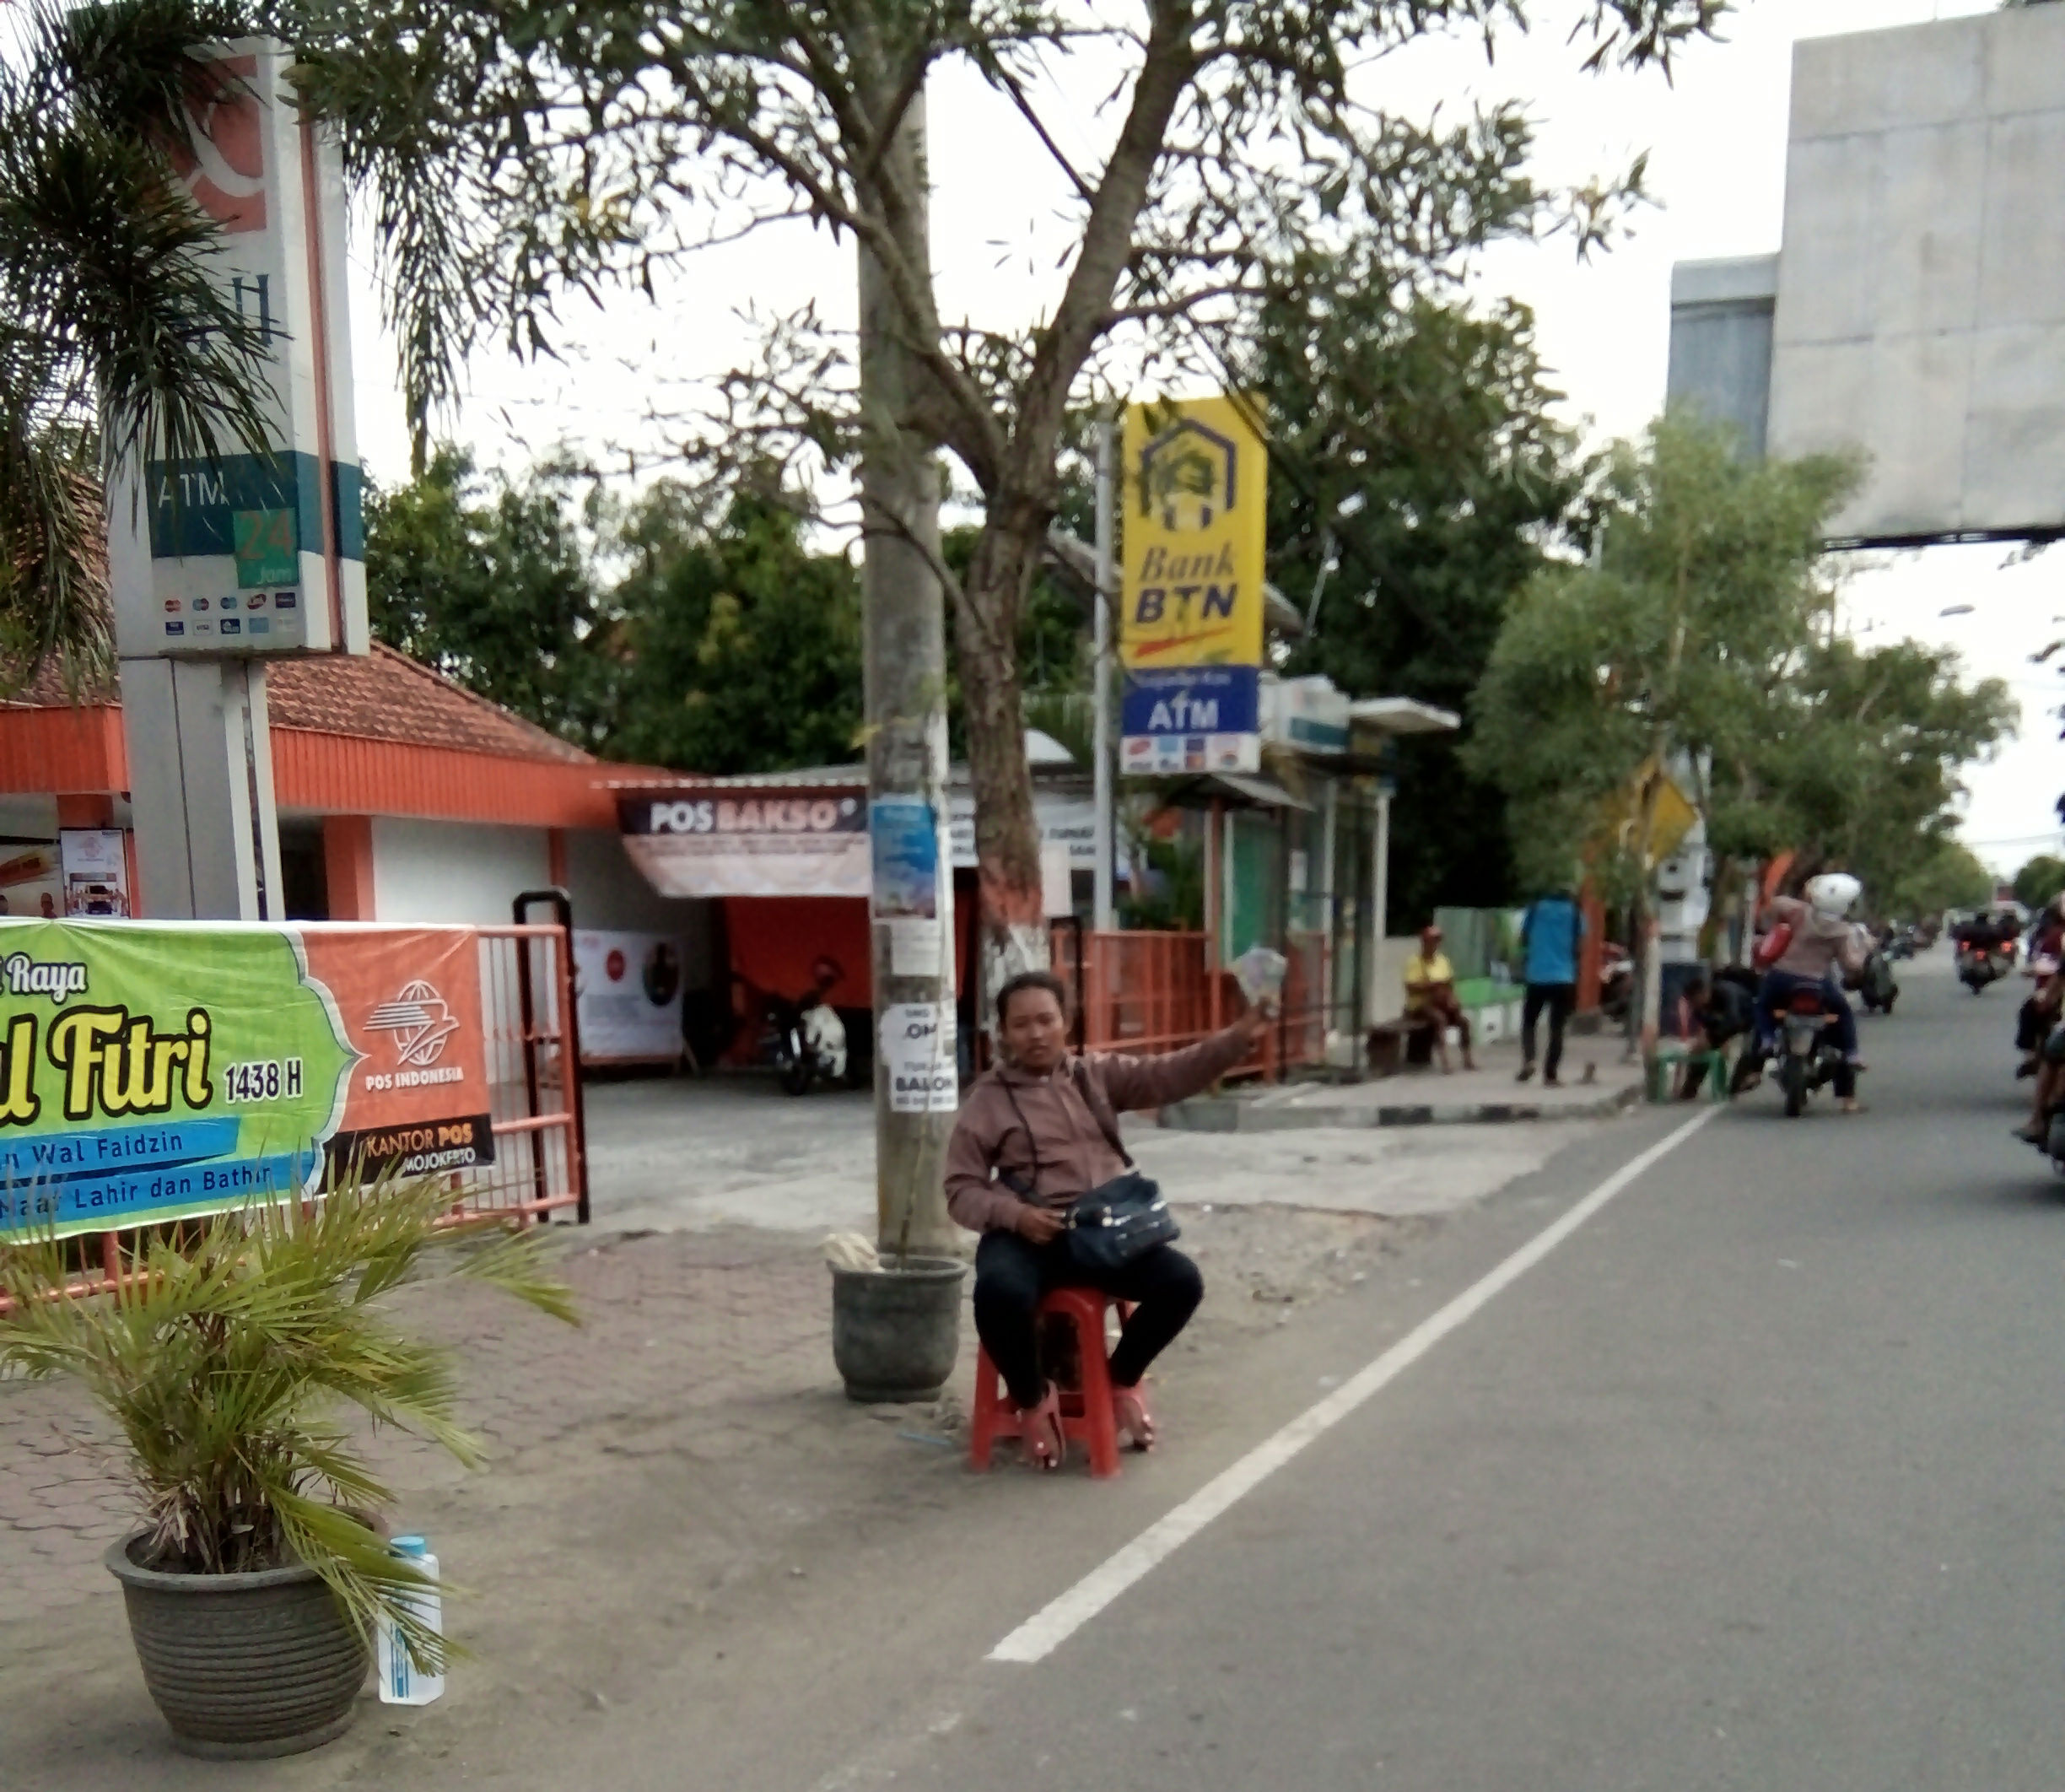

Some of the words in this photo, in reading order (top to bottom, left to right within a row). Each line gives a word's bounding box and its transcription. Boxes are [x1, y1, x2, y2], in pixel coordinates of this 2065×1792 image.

[158, 471, 230, 508] ATM
[240, 509, 293, 559] 24
[1139, 540, 1235, 581] Bank
[1136, 582, 1238, 623] BTN
[1147, 699, 1220, 730] ATM
[650, 802, 714, 832] POS
[717, 800, 837, 831] BAKSO
[6, 952, 89, 1005] Raya
[46, 1005, 213, 1121] Fitri
[224, 1061, 280, 1102] 1438
[286, 1059, 302, 1096] H
[366, 1075, 392, 1091] POS
[396, 1066, 465, 1088] INDONESIA
[32, 1140, 84, 1164] Wal
[98, 1132, 183, 1159] Faidzin
[366, 1129, 434, 1158] KANTOR
[438, 1122, 473, 1147] POS
[75, 1184, 137, 1209] Lahir
[150, 1176, 191, 1198] dan
